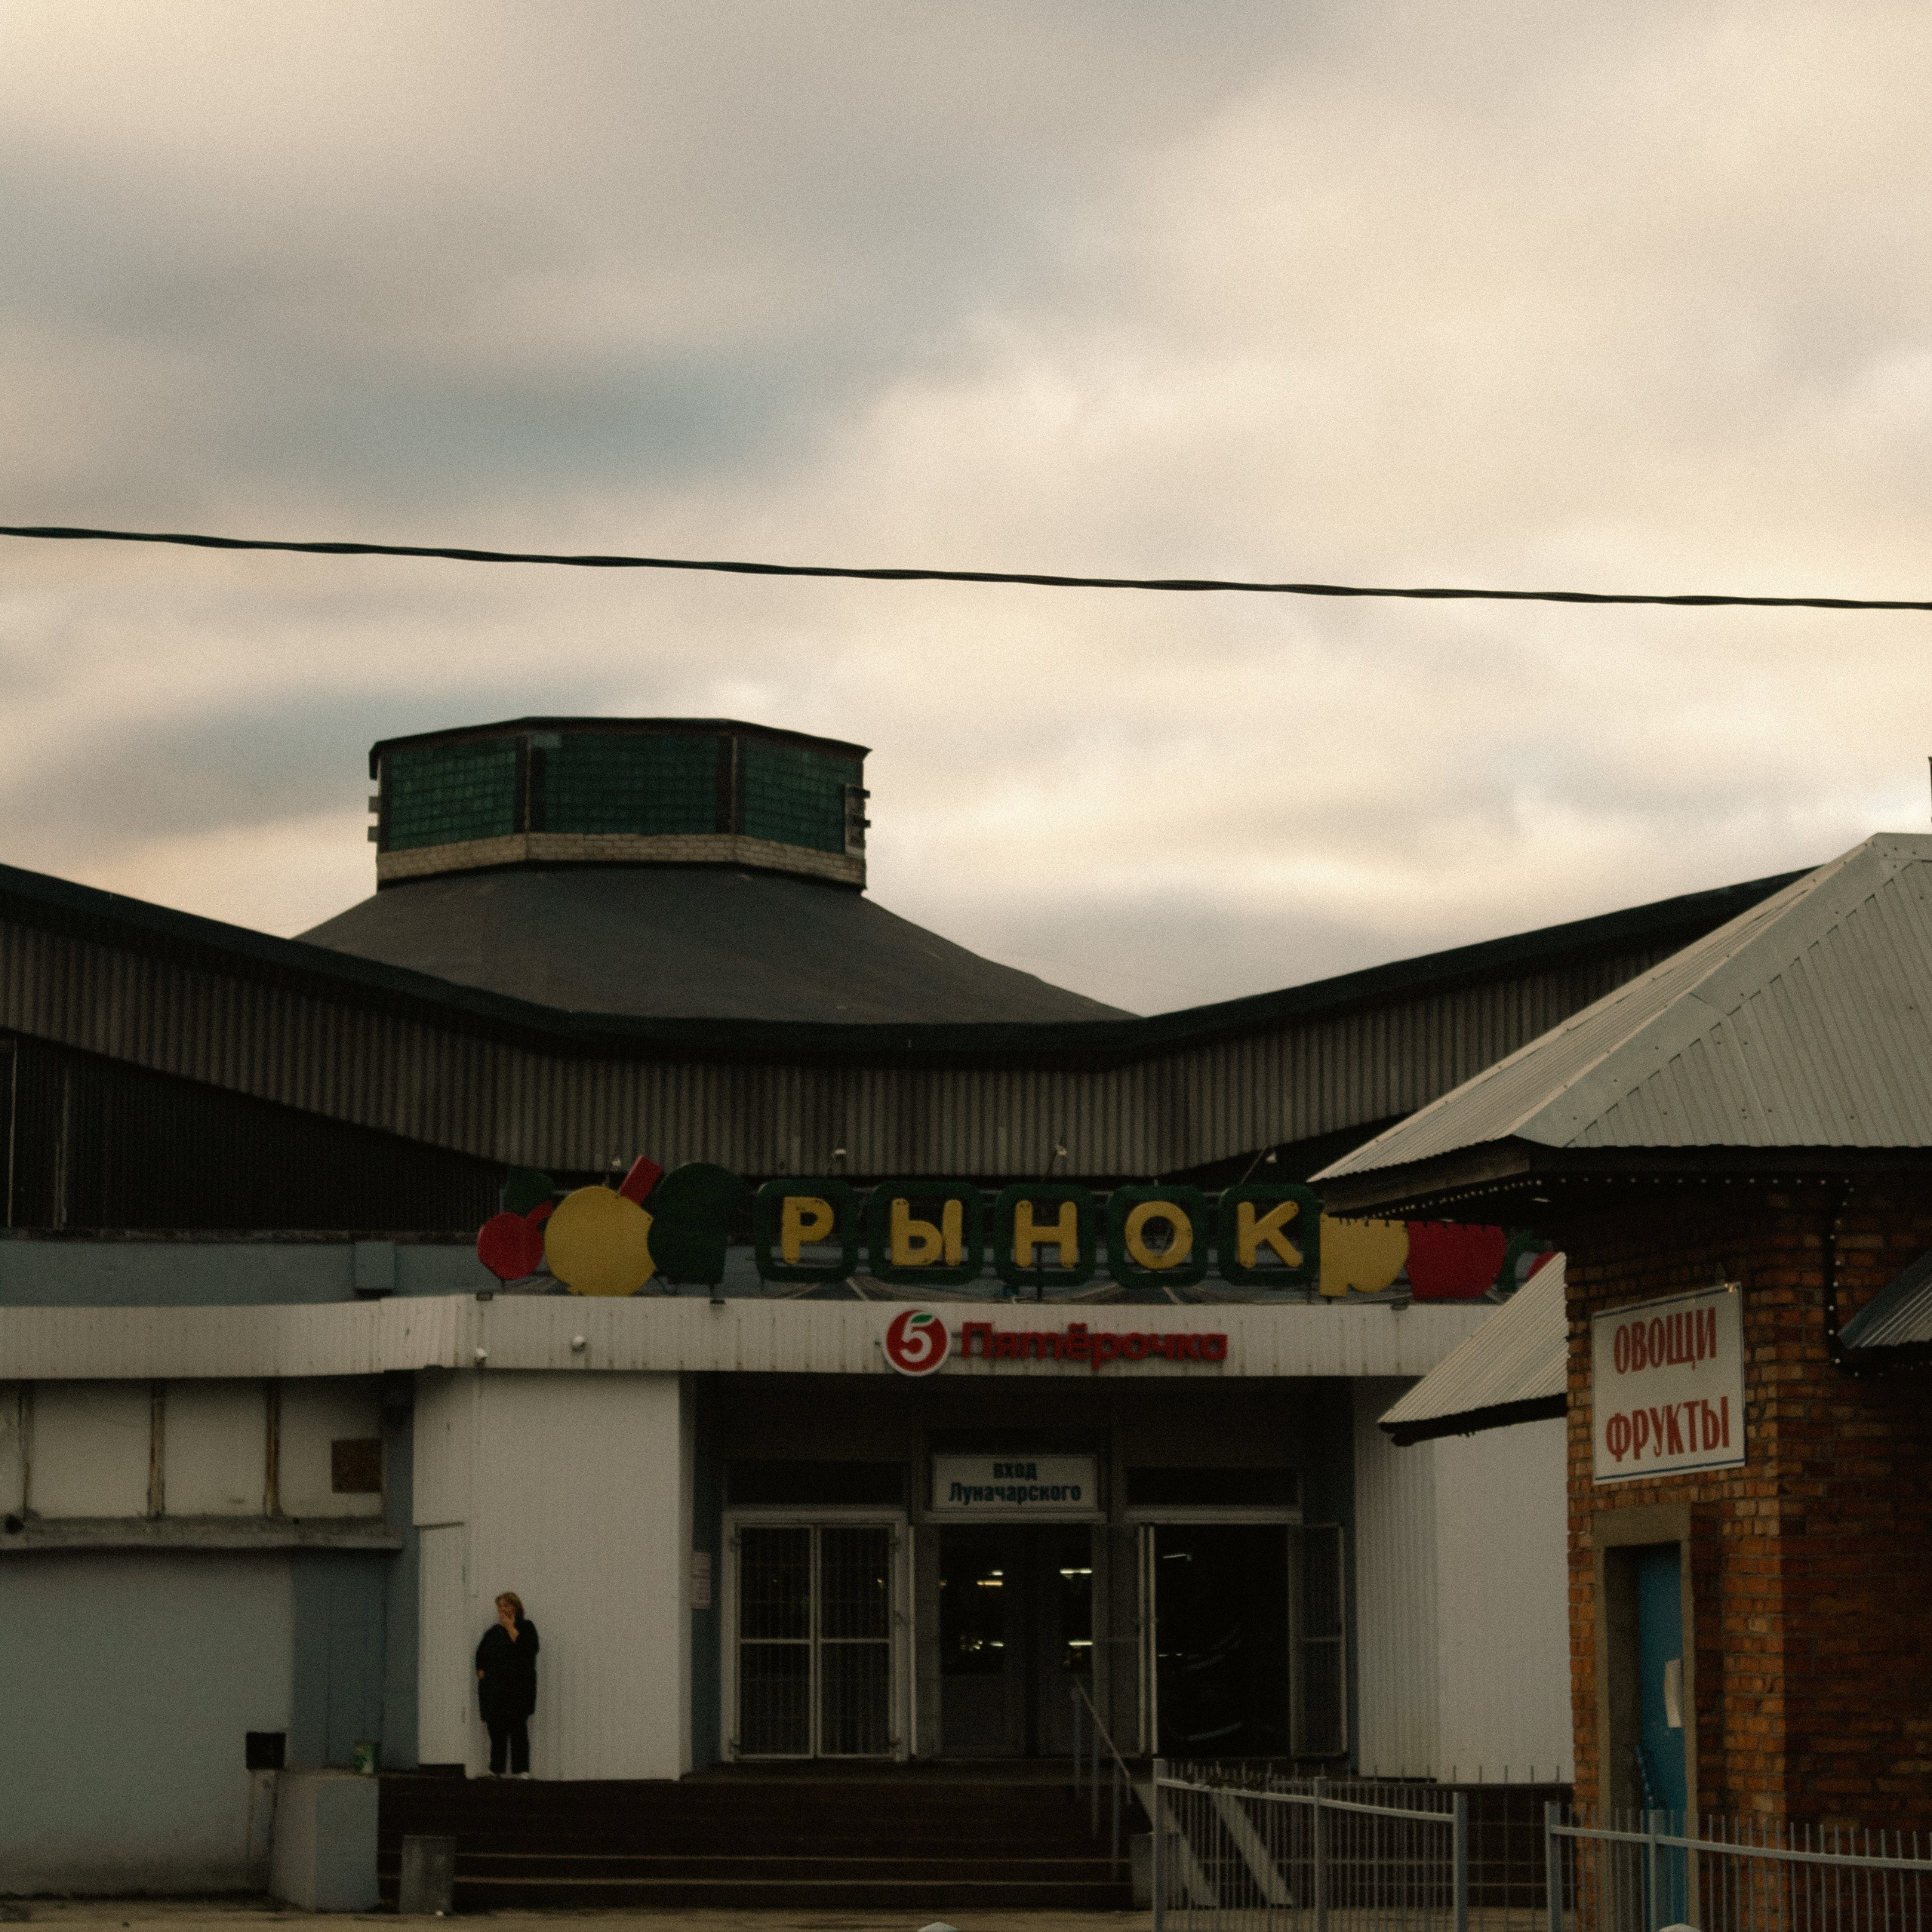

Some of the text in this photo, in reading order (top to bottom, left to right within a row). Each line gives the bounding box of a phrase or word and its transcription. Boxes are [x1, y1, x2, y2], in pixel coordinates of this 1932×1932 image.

[782, 1196, 1303, 1269] РЫНОК
[961, 1322, 1228, 1370] Пятёрочка
[1613, 1307, 1717, 1374] ОВОЩИ
[1605, 1396, 1730, 1463] ФРУКТЫ
[949, 1481, 1081, 1505] Луначарского
